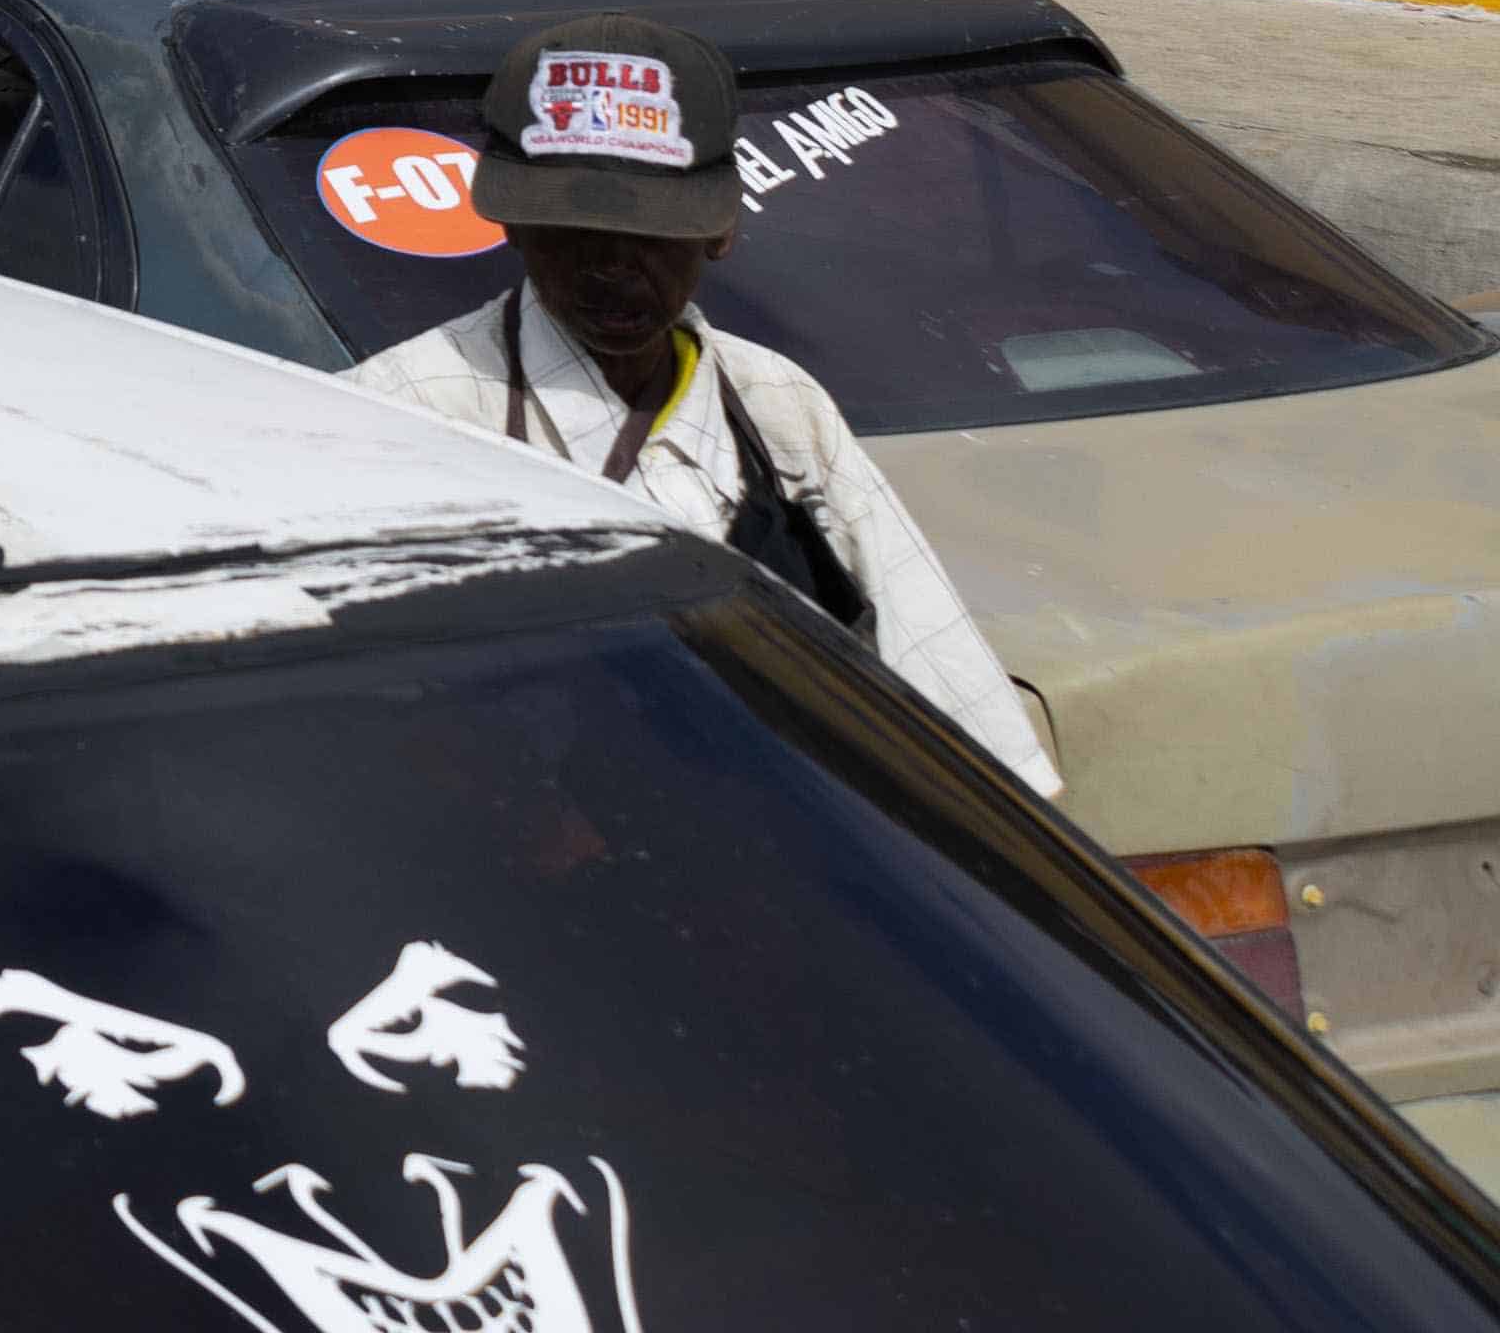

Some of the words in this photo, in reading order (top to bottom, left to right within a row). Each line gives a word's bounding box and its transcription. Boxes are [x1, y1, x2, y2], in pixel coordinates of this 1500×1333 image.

[548, 61, 661, 94] BULLS
[616, 101, 669, 134] 1991
[771, 86, 899, 180] AMIGO
[554, 134, 605, 146] WORLD
